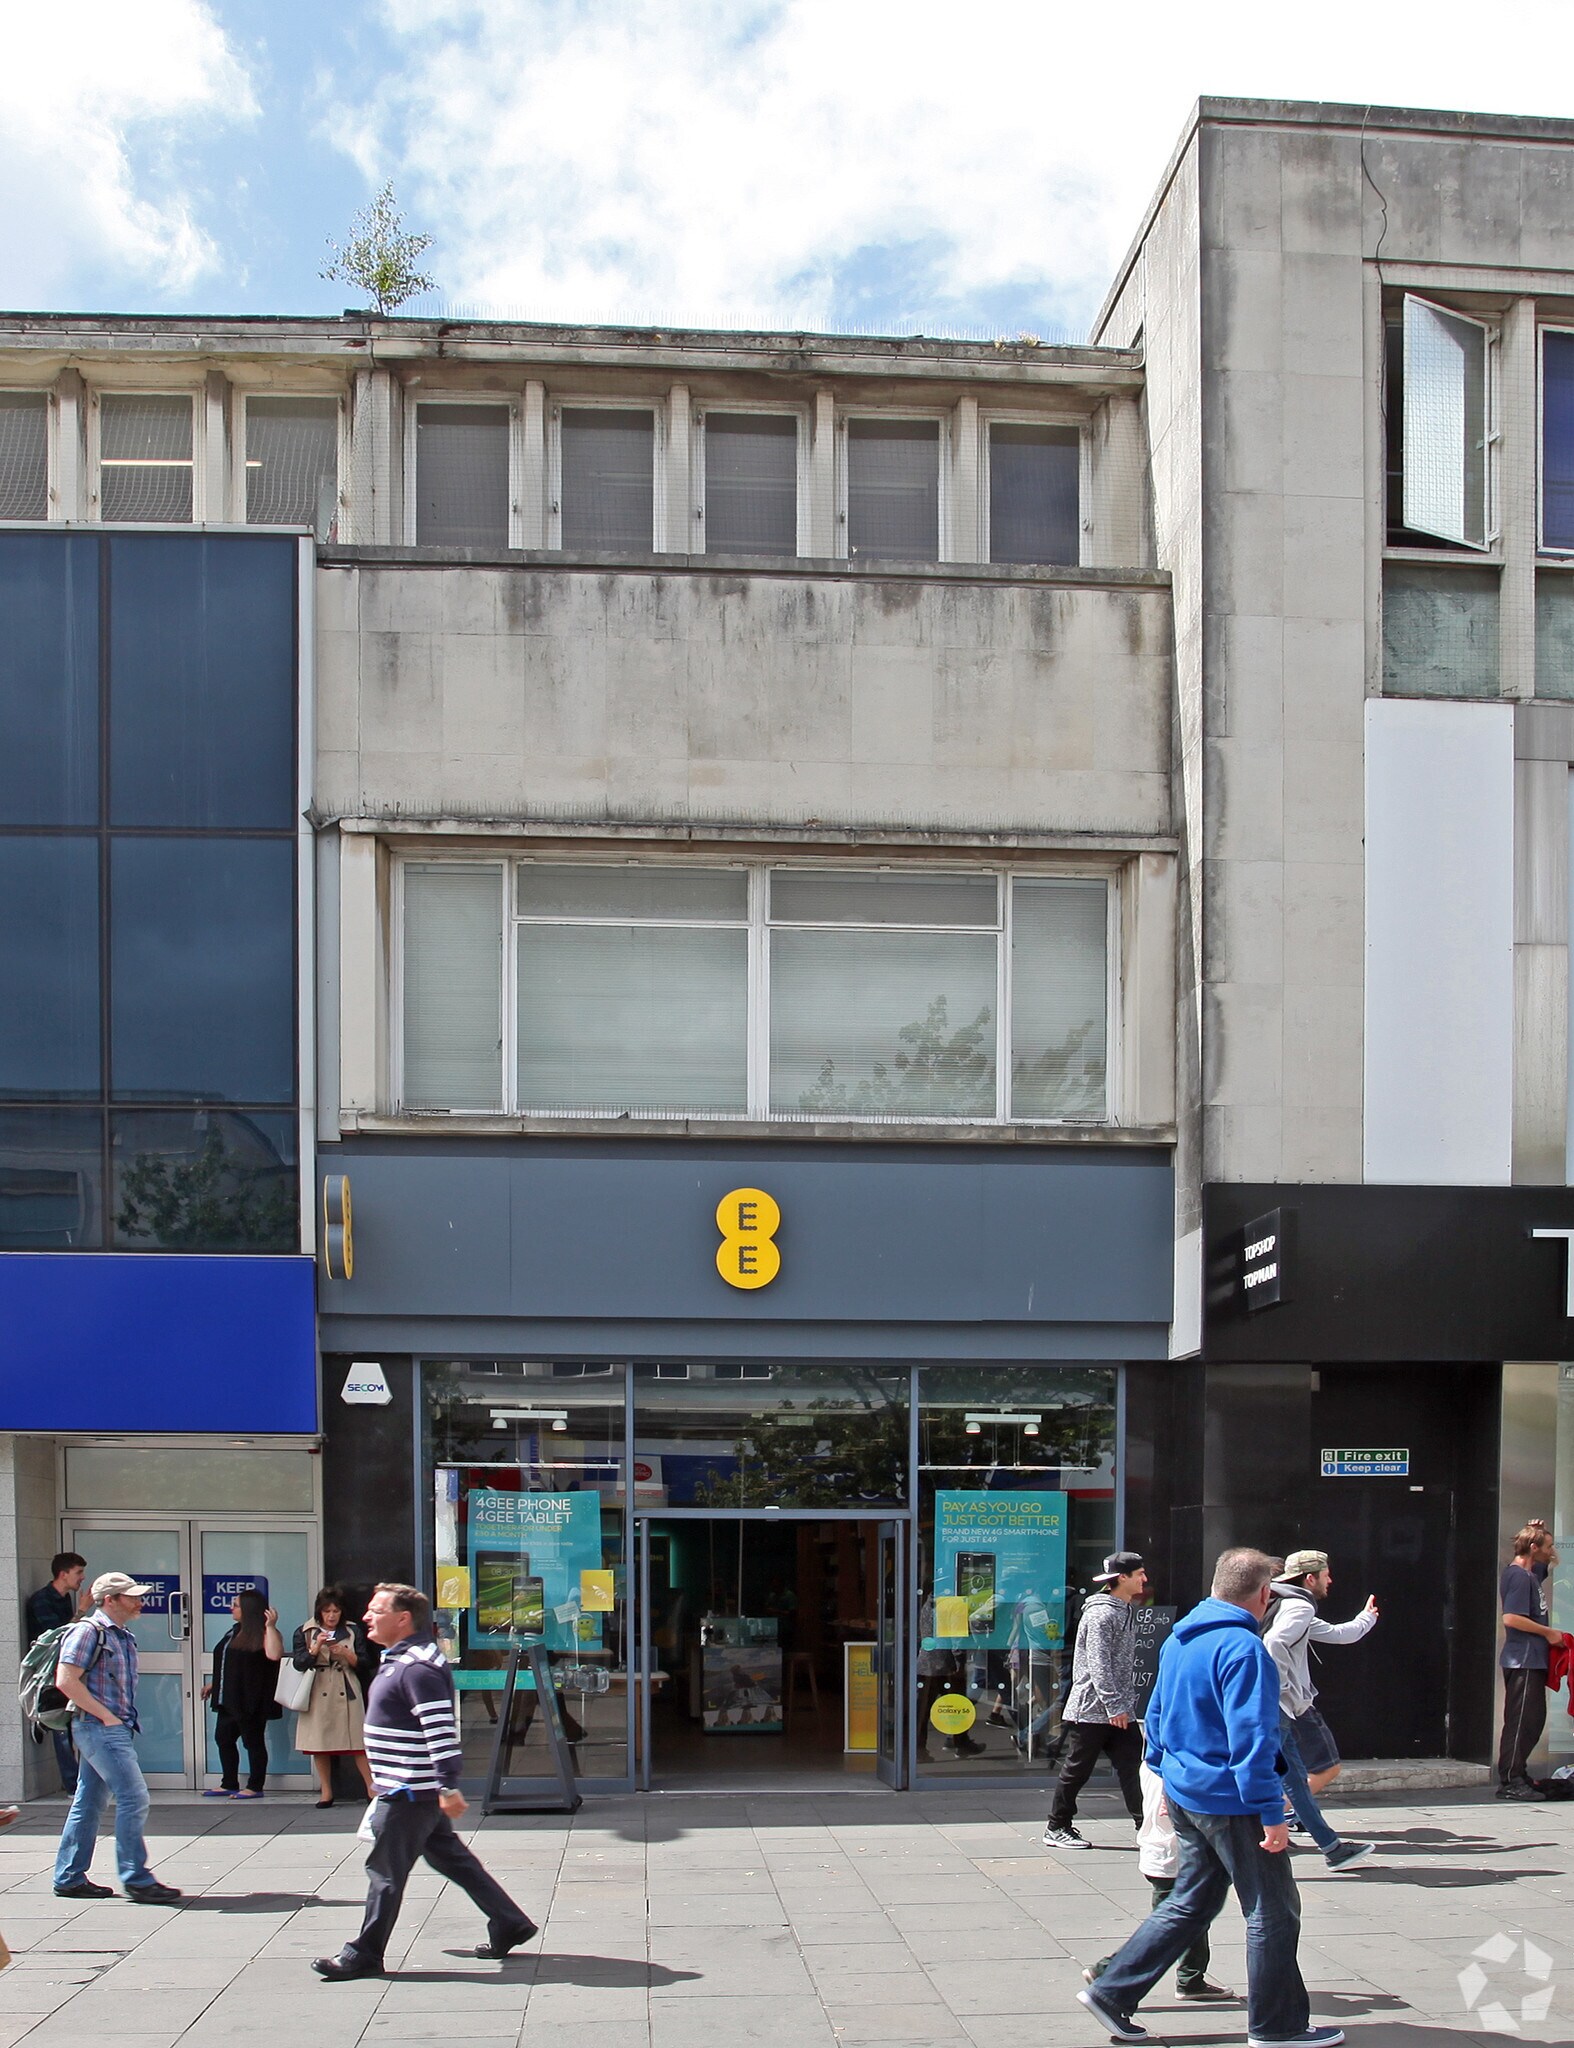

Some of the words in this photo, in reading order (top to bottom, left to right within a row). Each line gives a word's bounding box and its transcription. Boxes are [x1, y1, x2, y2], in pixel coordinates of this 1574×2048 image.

[1244, 1235, 1276, 1261] TOPSHOP
[1243, 1262, 1277, 1289] TOPMAN
[347, 1383, 385, 1392] SECOM
[1344, 1451, 1371, 1461] Fire
[1375, 1451, 1402, 1461] exit
[1344, 1464, 1371, 1473] Keep
[1375, 1464, 1401, 1472] clear
[475, 1497, 514, 1510] 4GEE
[517, 1499, 571, 1511] PHONE
[942, 1501, 967, 1513] PAY
[968, 1502, 987, 1513] AS
[987, 1502, 1018, 1513] YOU
[1020, 1502, 1042, 1513] GO
[475, 1511, 514, 1523] 4GEE
[516, 1512, 573, 1524] TABLET
[943, 1514, 976, 1526] JUST
[977, 1514, 1007, 1526] GOT
[1008, 1515, 1060, 1527] BETTER
[942, 1528, 970, 1536] BRAND
[971, 1528, 990, 1536] NEW
[990, 1528, 1002, 1536] 4G
[1003, 1528, 1060, 1537] SMARTPHONE
[142, 1595, 165, 1607] XIT
[1136, 1608, 1153, 1624] GB
